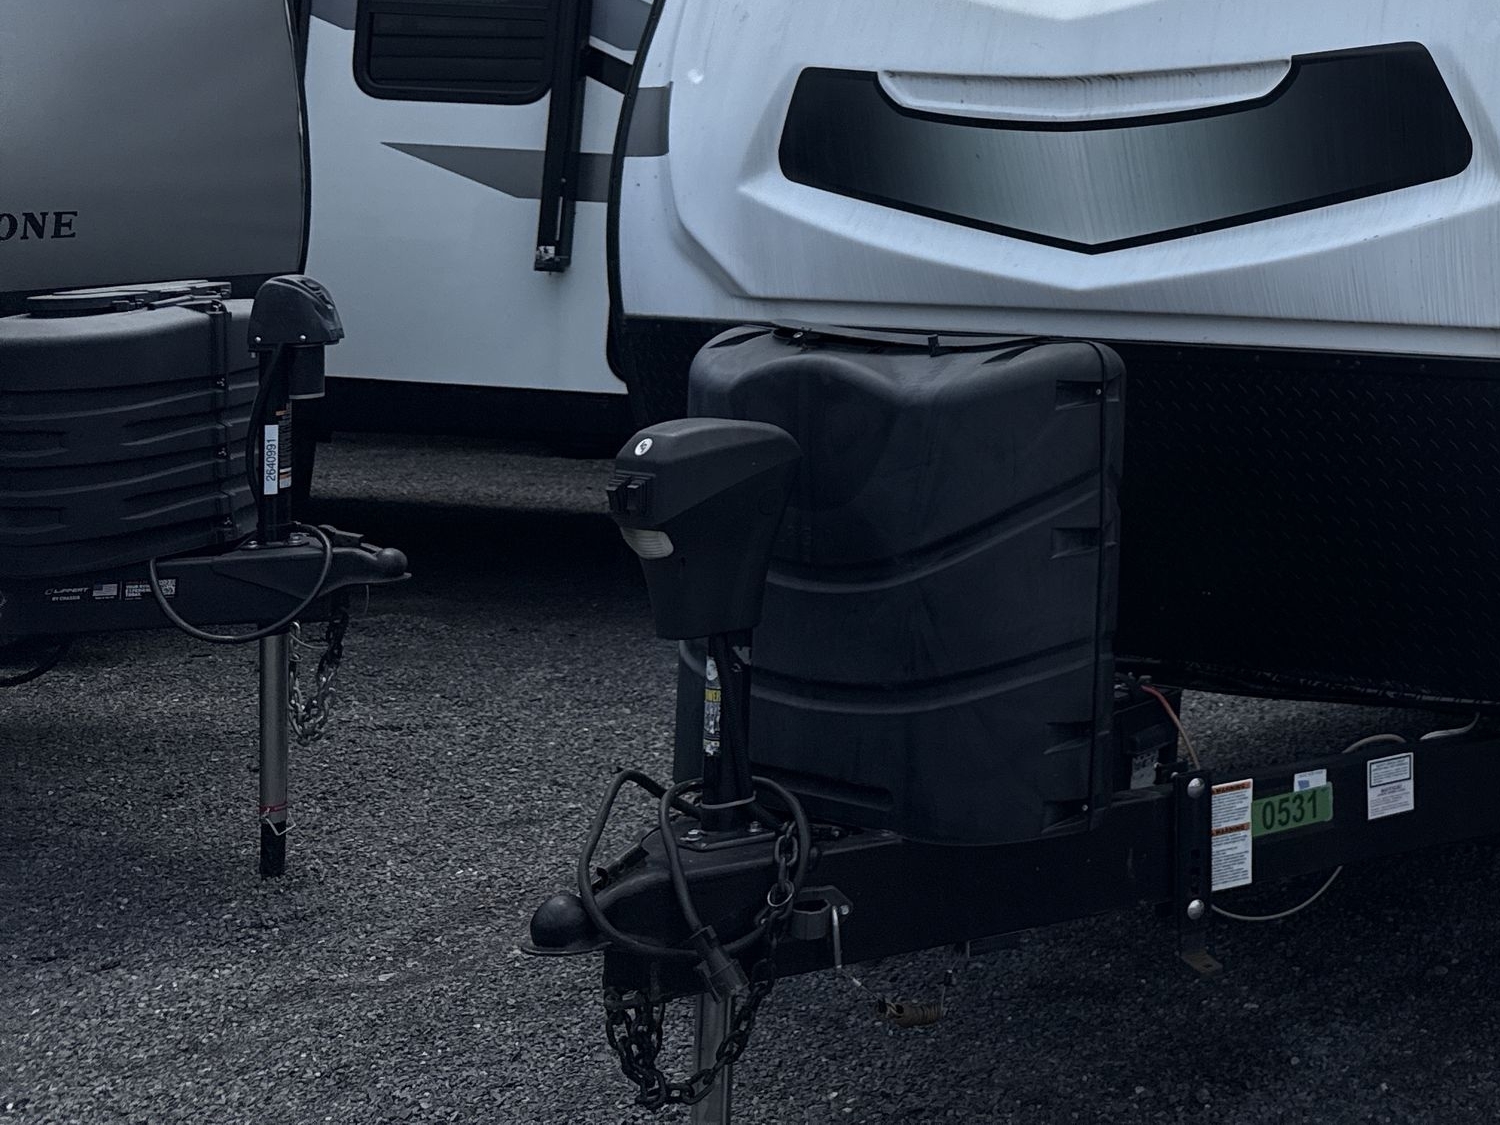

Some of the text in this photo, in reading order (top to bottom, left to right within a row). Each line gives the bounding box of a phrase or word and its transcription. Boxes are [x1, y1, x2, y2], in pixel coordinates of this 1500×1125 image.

[0, 211, 78, 241] ONE
[266, 439, 276, 481] 2640991
[1262, 791, 1318, 830] 0531
